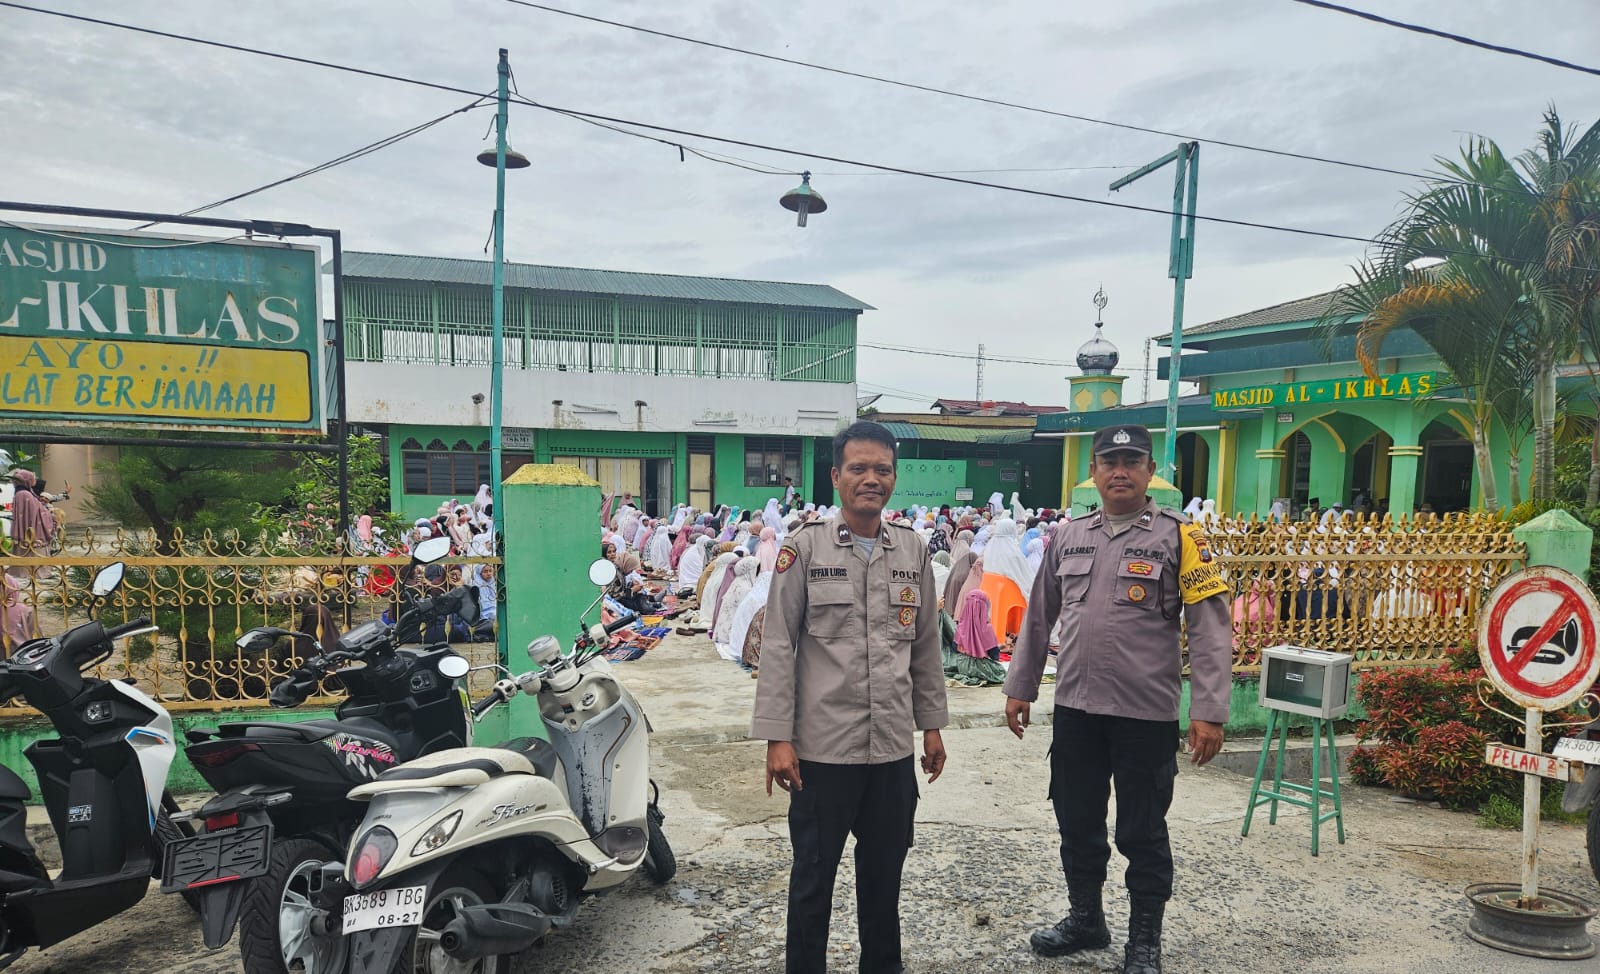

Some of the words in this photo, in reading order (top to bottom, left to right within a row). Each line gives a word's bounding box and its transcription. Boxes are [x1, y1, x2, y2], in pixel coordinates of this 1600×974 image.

[1214, 387, 1274, 407] MASJID
[1124, 548, 1164, 560] POLRI
[1492, 746, 1540, 772] PELAN
[396, 887, 423, 906] TBG
